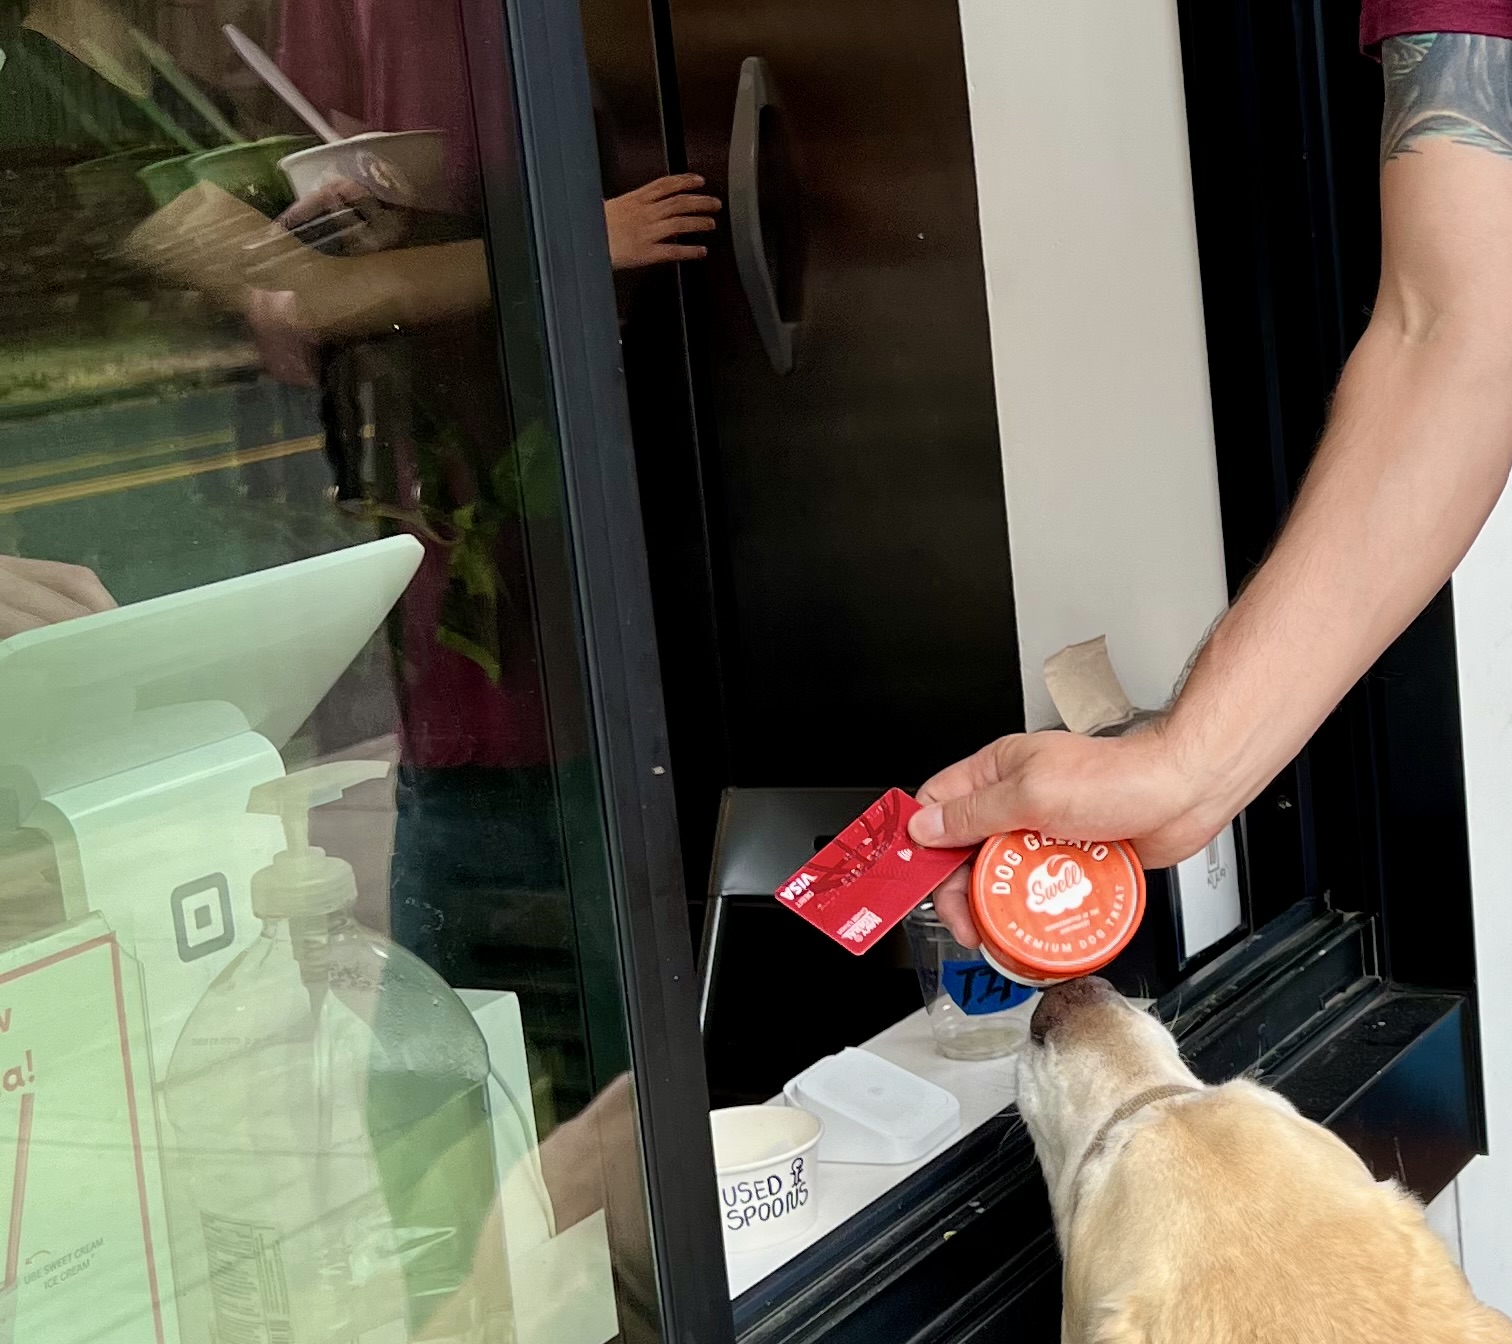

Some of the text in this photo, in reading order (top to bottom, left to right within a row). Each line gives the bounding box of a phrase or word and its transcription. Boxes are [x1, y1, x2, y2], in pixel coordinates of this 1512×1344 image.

[778, 872, 818, 903] VISA
[992, 849, 1023, 895] DOG
[1031, 864, 1083, 905] Swell
[1007, 921, 1073, 953] PREMIUM
[1079, 928, 1106, 950] DOG
[1105, 885, 1126, 927] TREAT
[722, 1175, 782, 1207] USED
[727, 1181, 809, 1231] SPOONS
[43, 1253, 72, 1276] SWEET
[73, 1236, 104, 1259] CREAM
